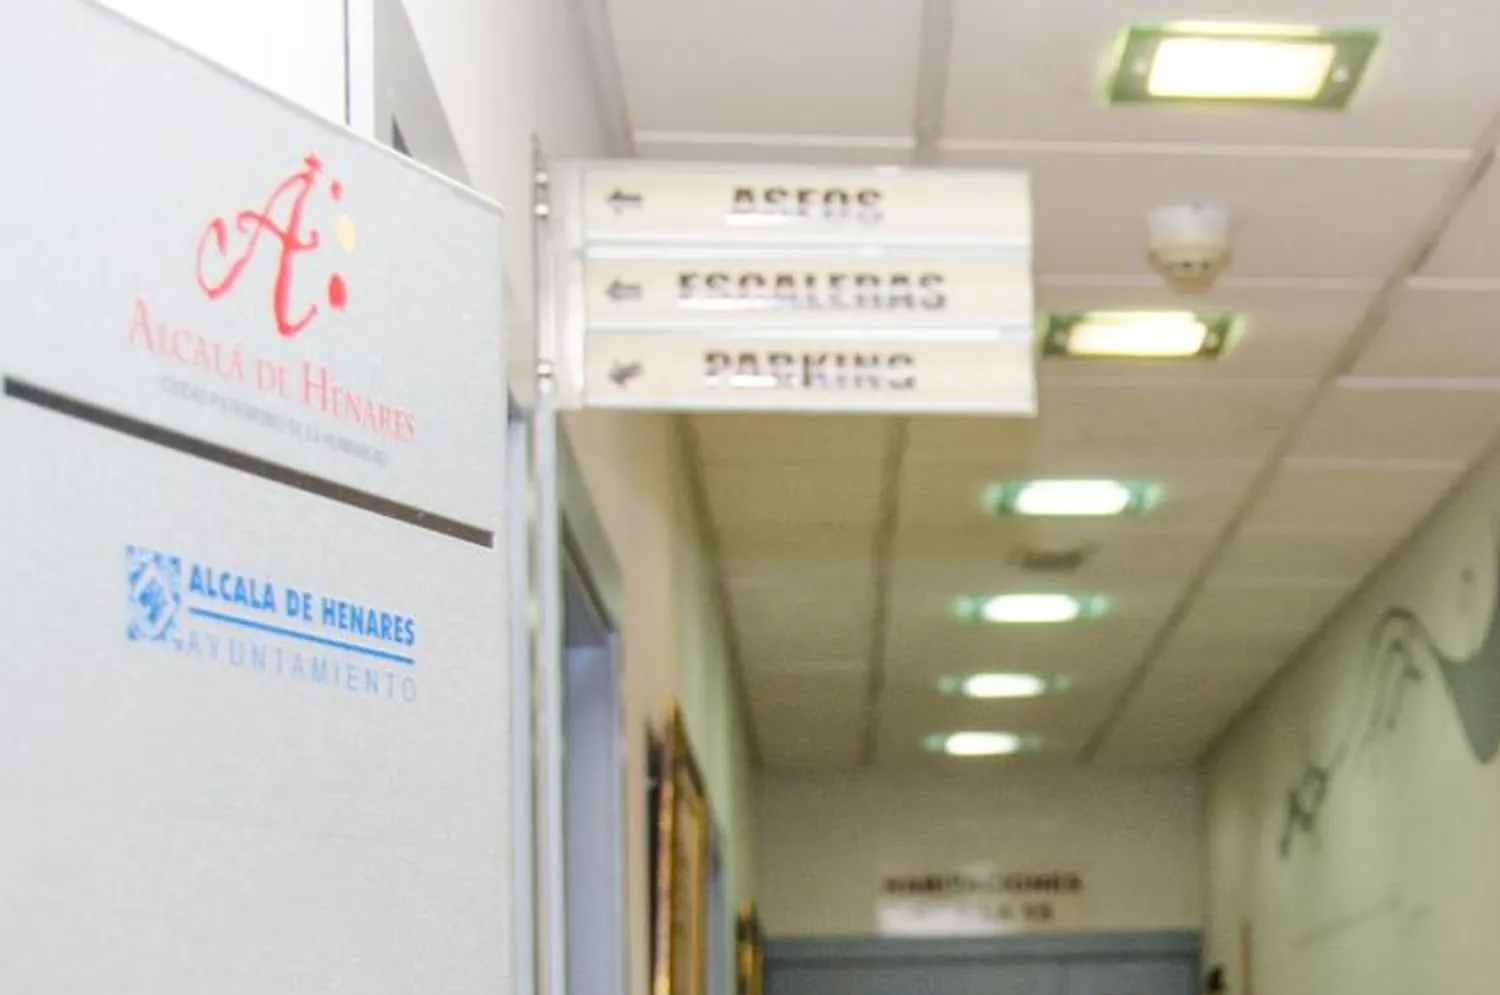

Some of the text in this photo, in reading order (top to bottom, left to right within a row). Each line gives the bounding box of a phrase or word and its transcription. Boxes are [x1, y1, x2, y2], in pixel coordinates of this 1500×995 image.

[731, 186, 885, 224] ASEOS
[676, 272, 948, 312] ESCALERAS
[127, 297, 416, 442] ALCALÁ DE HENARES
[704, 350, 918, 391] PARKING
[285, 587, 314, 622] DE
[320, 597, 416, 647] HENARES
[182, 629, 418, 703] AYUNTAMIENTO
